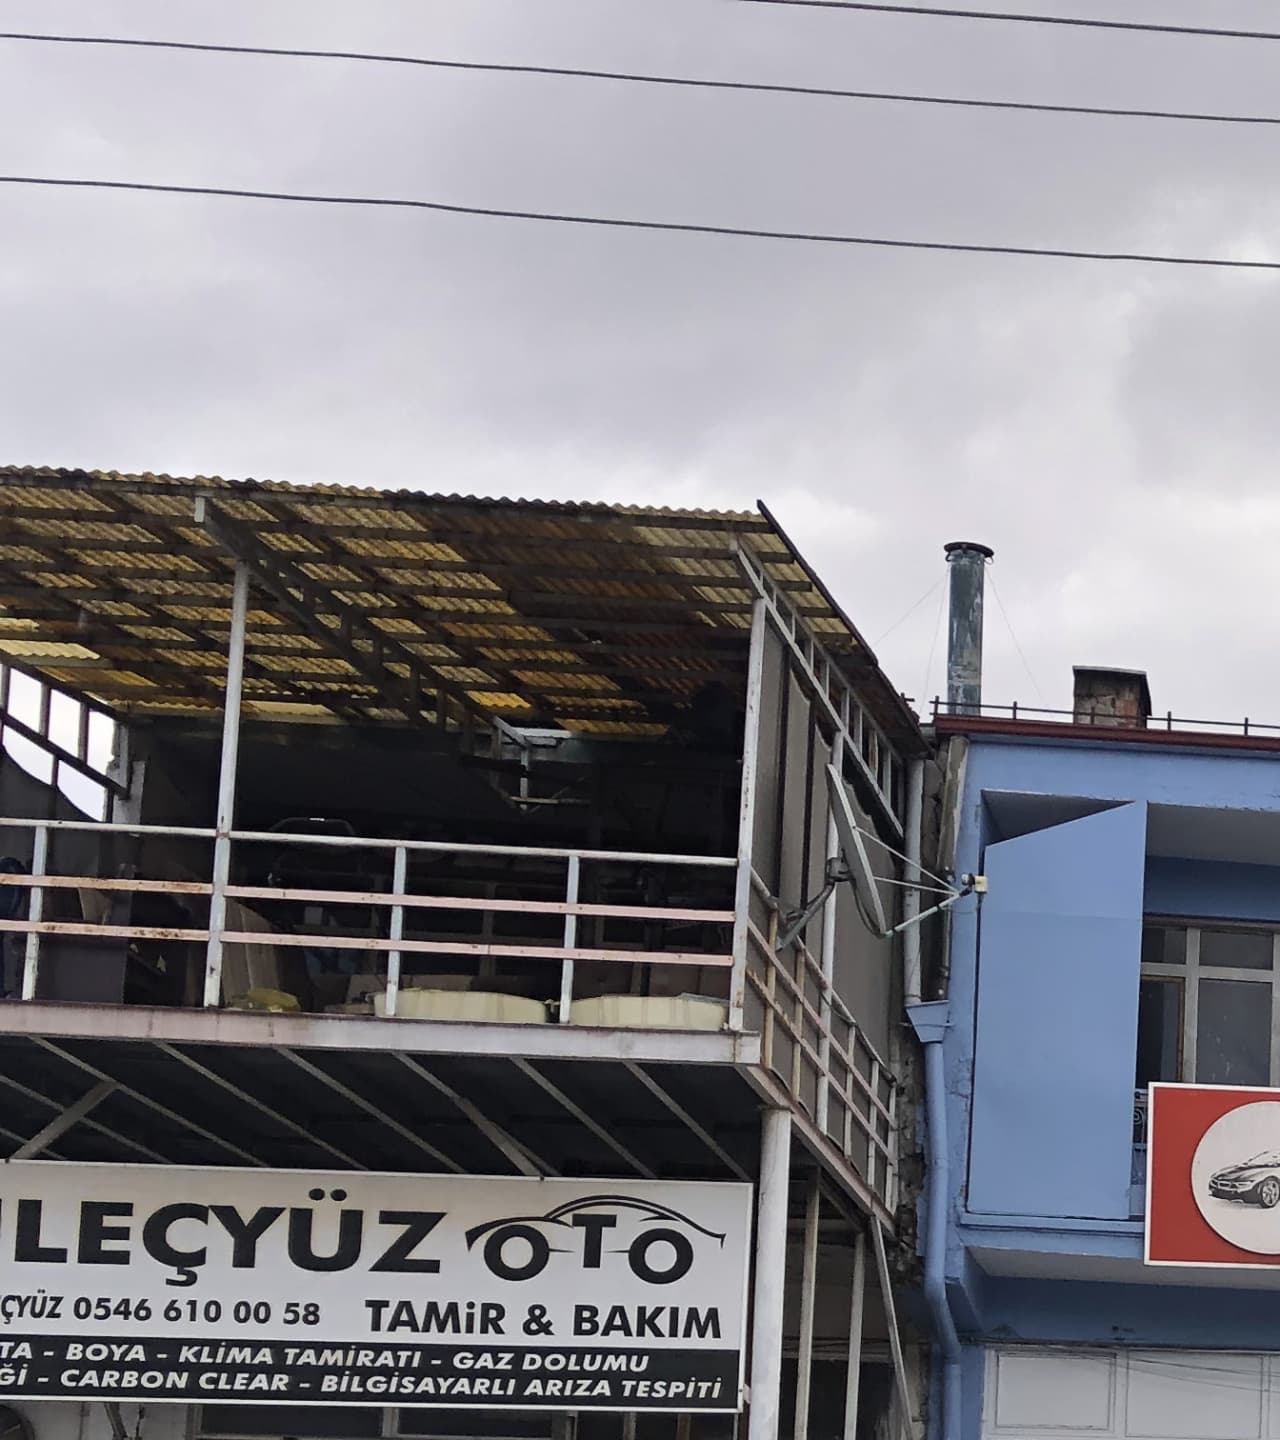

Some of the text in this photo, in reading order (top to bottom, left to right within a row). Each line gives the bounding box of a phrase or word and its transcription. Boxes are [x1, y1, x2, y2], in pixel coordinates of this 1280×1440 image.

[0, 1188, 694, 1287] LEÇYÜZ OTO
[0, 1289, 321, 1326] ÇYÜZ 0546 610 00 58
[521, 1306, 556, 1337] &
[572, 1304, 723, 1340] BAKIM
[66, 1343, 147, 1362] BOYA
[178, 1341, 274, 1366] KLİMA
[284, 1345, 421, 1370] TAMİRATI
[454, 1350, 511, 1371] GAZ
[522, 1353, 650, 1374] DOLUMU
[60, 1369, 189, 1389] CARBON
[199, 1373, 290, 1391] CLEAR
[321, 1371, 516, 1397] BİLGİSAYARLI
[523, 1377, 613, 1398] ARIZA
[621, 1376, 722, 1400] TESPİTİ
